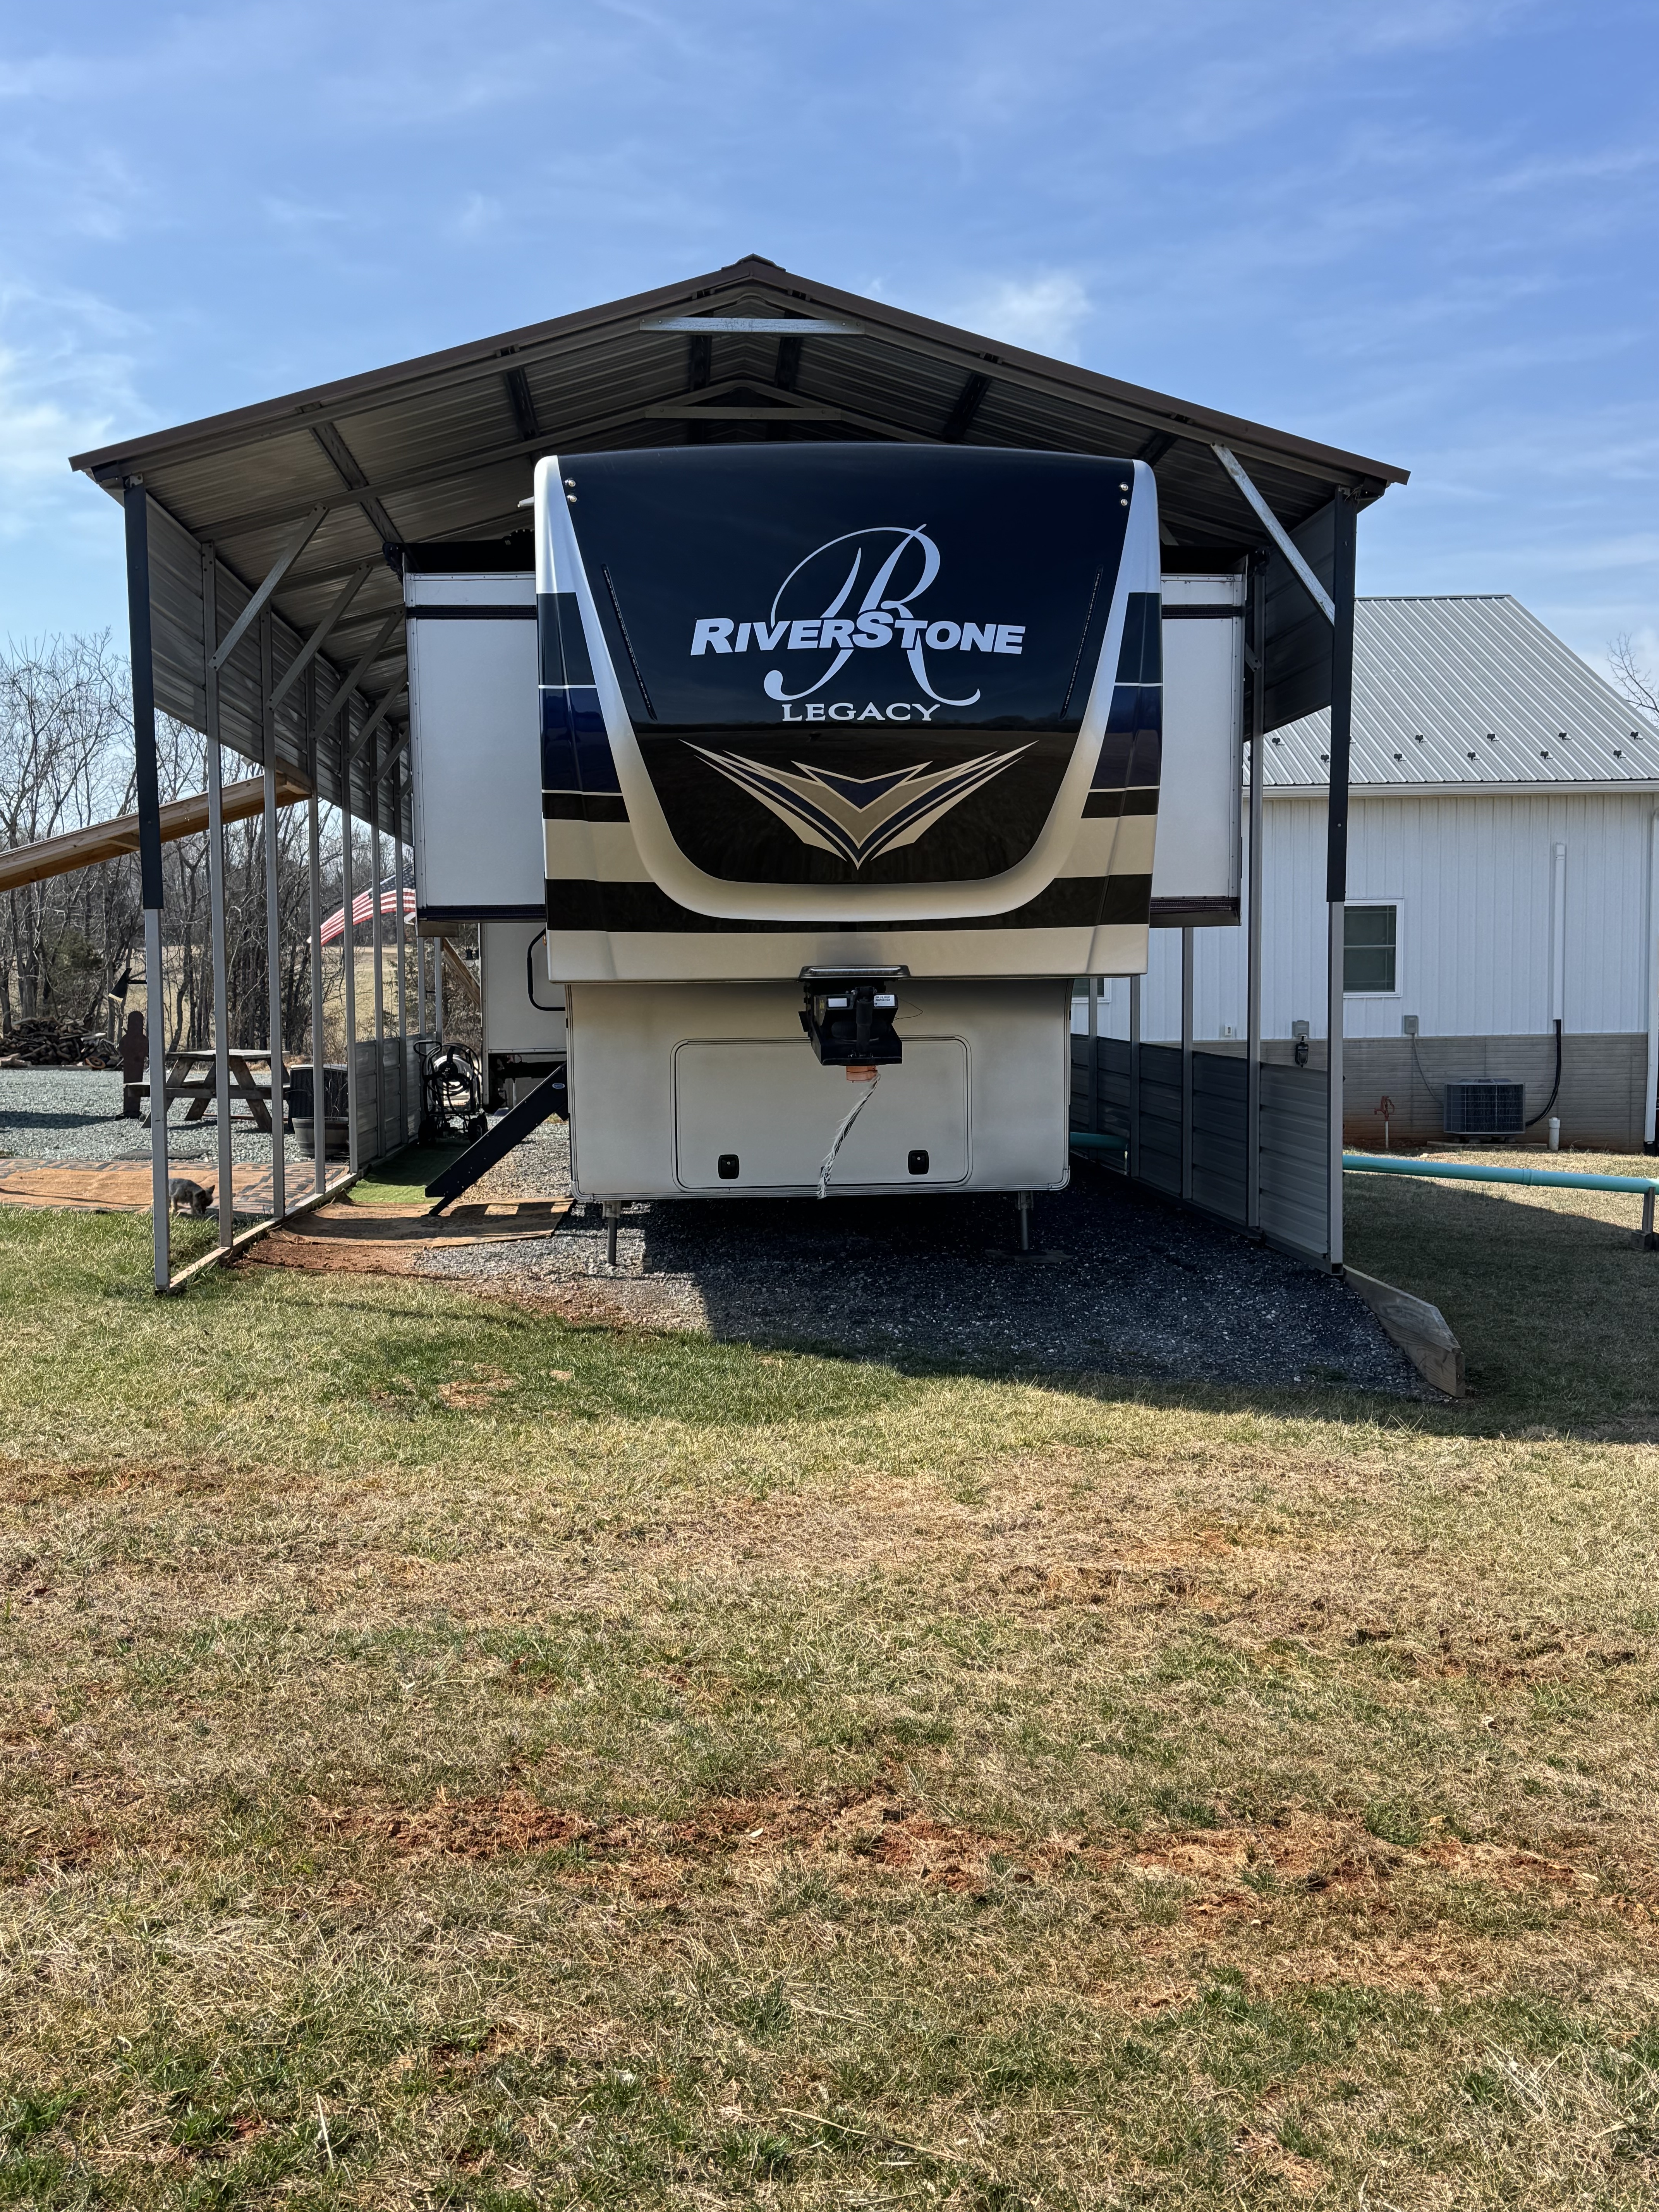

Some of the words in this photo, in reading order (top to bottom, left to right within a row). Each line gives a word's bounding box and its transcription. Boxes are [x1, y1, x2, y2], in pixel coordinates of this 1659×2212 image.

[691, 611, 1026, 655] RIVERSTONE
[764, 524, 980, 706] R
[782, 702, 941, 721] LEGACY
